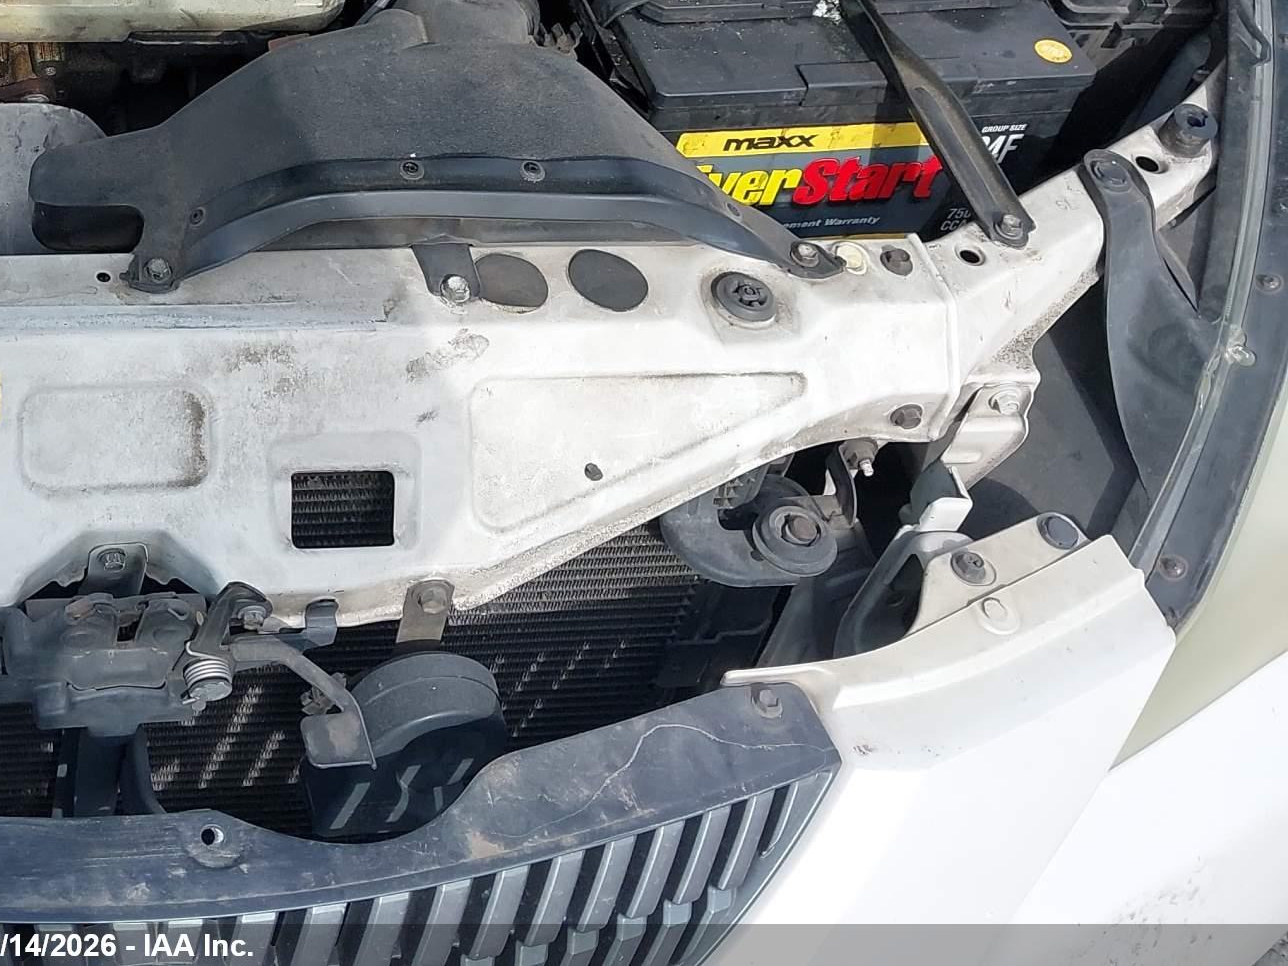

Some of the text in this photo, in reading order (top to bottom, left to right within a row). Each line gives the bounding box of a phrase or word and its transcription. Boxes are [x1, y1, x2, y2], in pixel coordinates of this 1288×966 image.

[981, 123, 1027, 134] GROUP SIZE
[723, 133, 819, 152] maxx
[697, 154, 944, 207] verStart
[824, 215, 881, 227] Warranty
